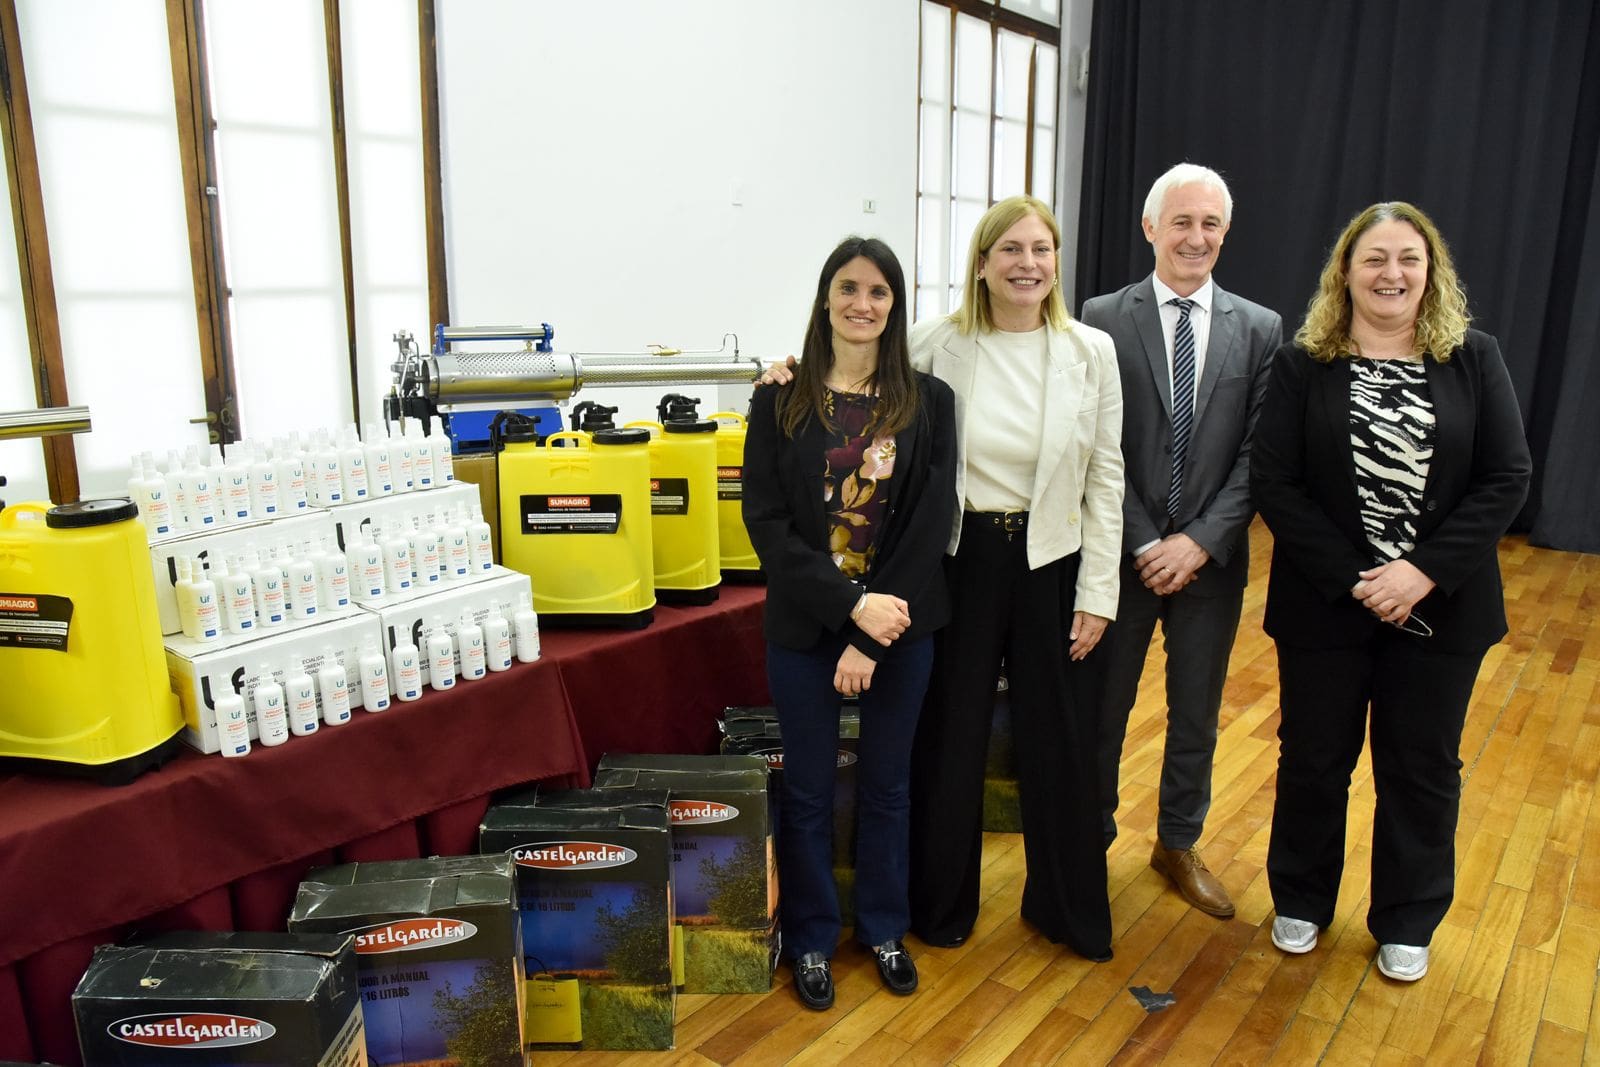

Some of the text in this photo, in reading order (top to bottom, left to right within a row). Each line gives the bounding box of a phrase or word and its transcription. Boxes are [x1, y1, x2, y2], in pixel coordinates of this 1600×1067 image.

[674, 842, 698, 851] ANUAL
[356, 921, 466, 945] STElGARdEN
[390, 970, 430, 983] MANUAL
[366, 987, 410, 1001] 16 LITROS
